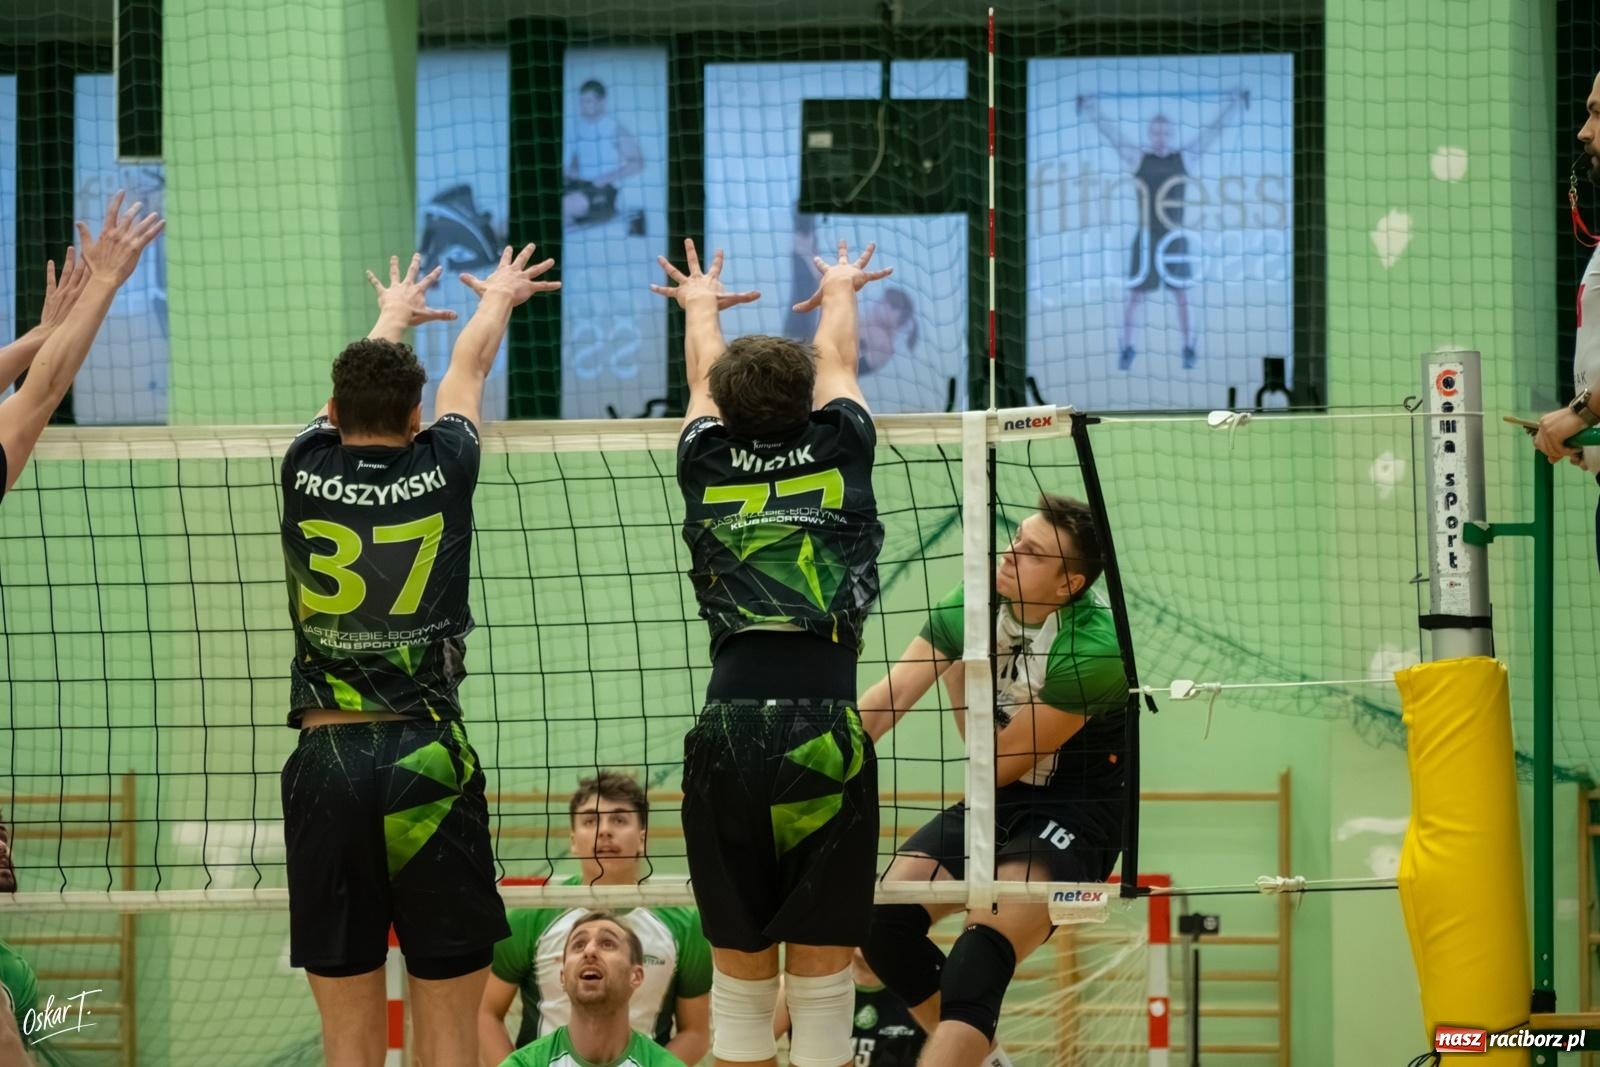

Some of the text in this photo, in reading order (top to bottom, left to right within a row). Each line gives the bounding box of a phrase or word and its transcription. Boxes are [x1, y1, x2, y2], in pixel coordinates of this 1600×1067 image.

[1033, 162, 1287, 232] fitness
[1004, 416, 1052, 431] netex
[294, 465, 447, 506] PRÓSZYŃSKI
[730, 517, 761, 531] KLUB
[1445, 472, 1459, 569] sport
[297, 512, 445, 615] 37
[320, 635, 432, 650] KLUB SPORTOWY
[1038, 819, 1076, 850] 16
[1053, 891, 1103, 902] netex
